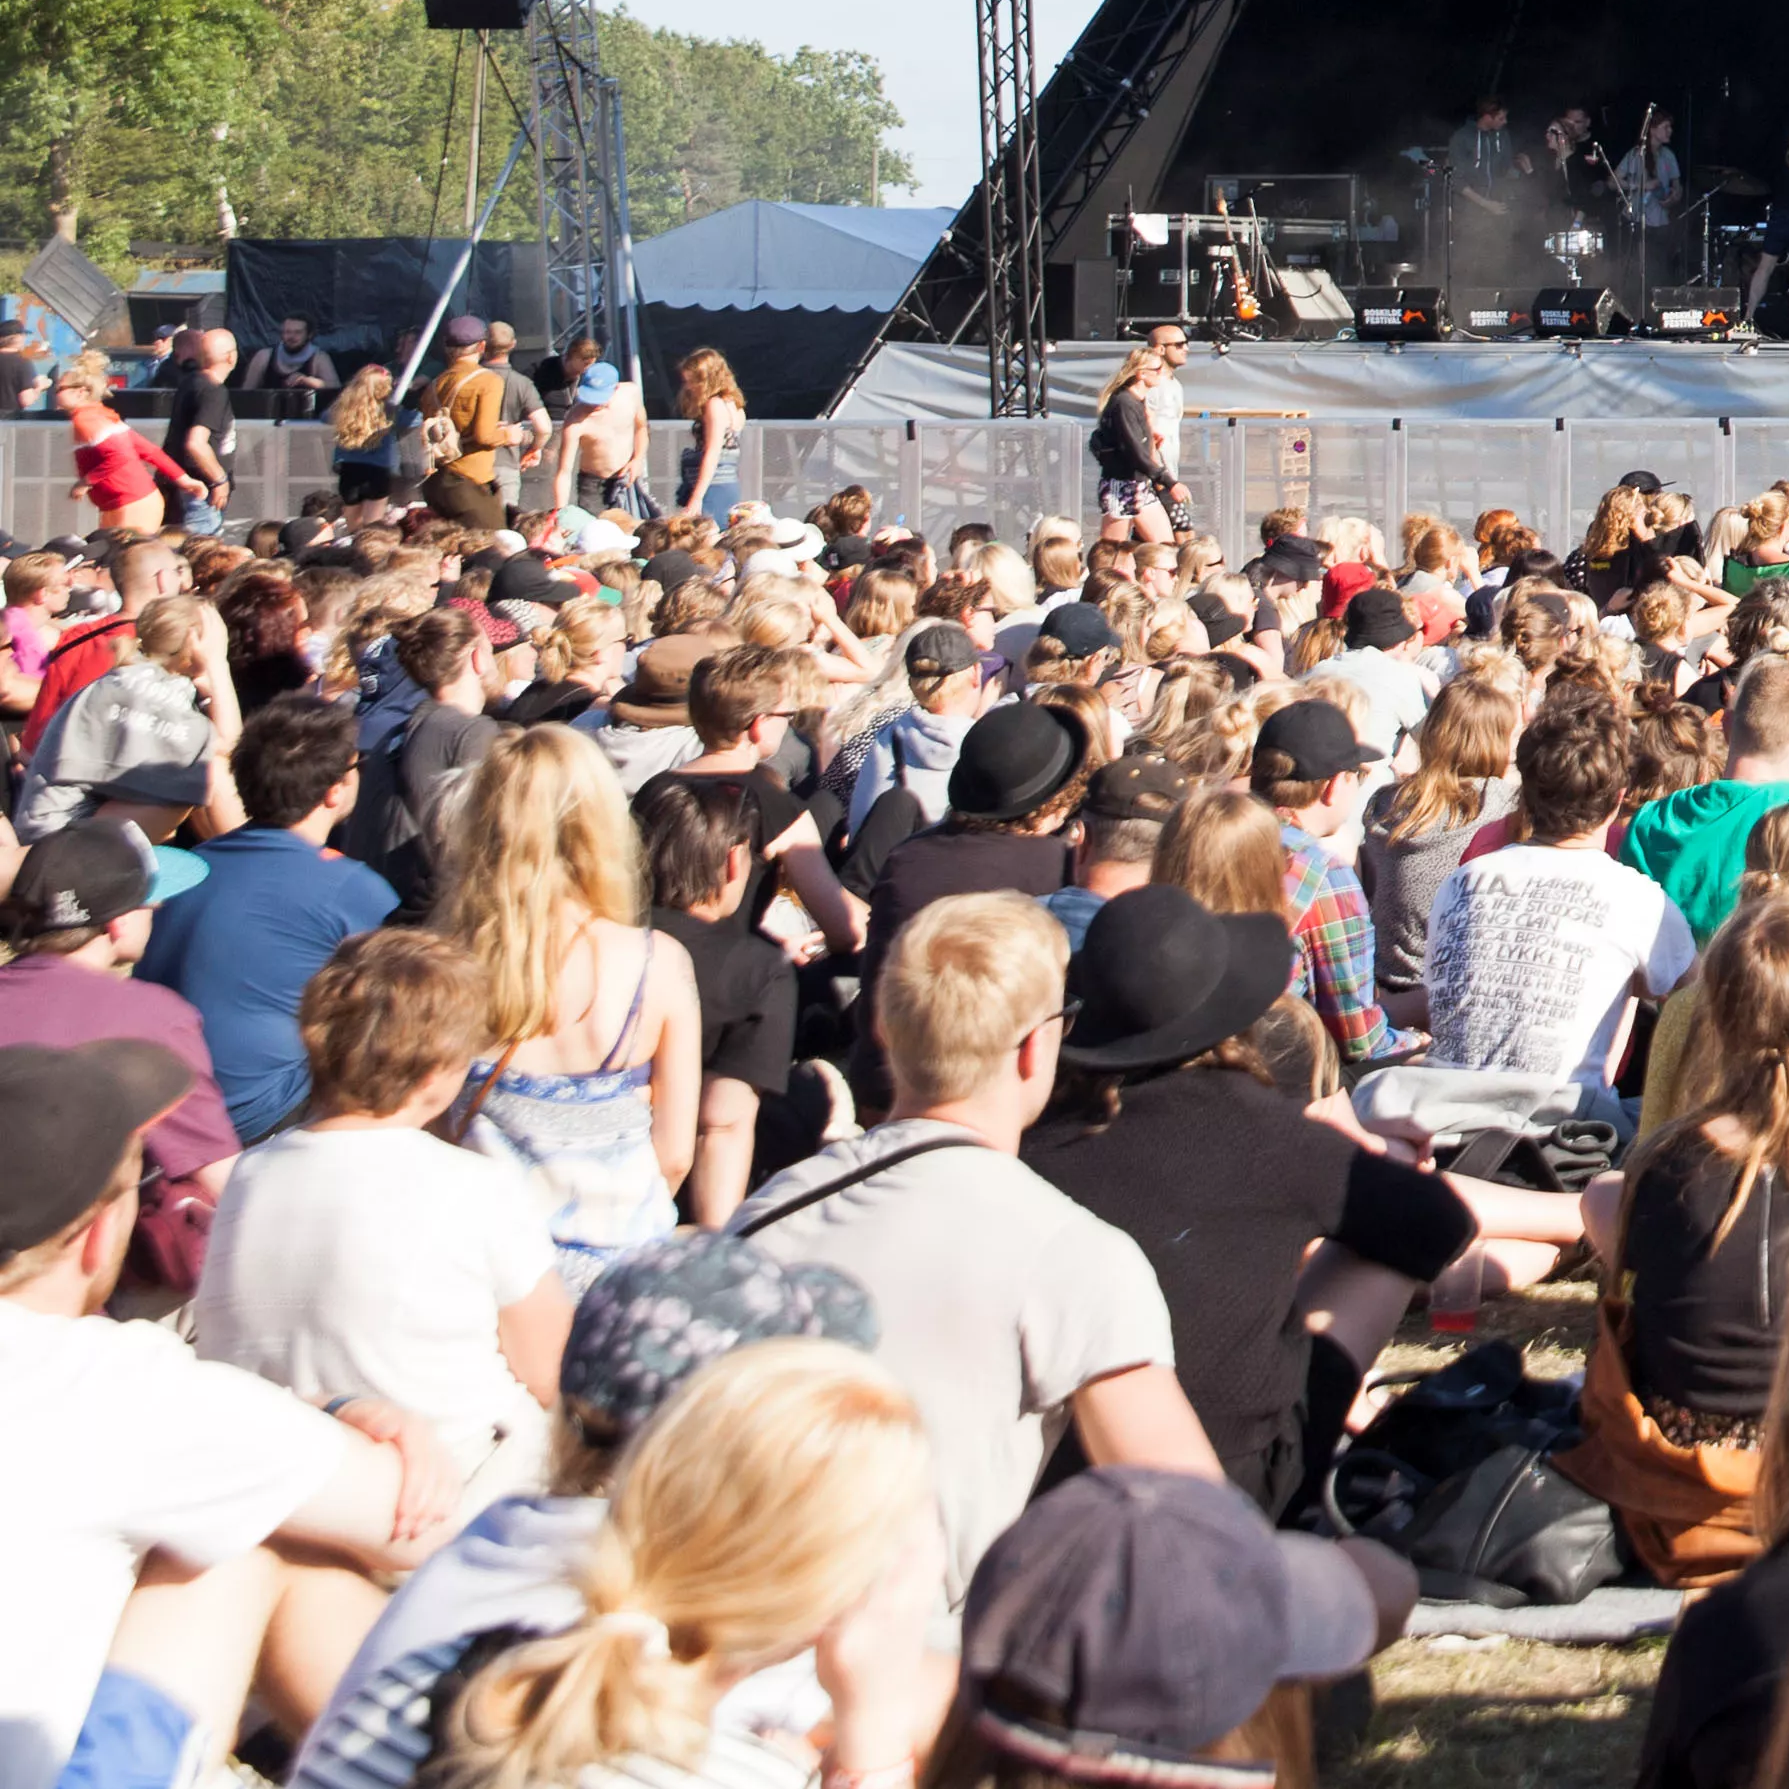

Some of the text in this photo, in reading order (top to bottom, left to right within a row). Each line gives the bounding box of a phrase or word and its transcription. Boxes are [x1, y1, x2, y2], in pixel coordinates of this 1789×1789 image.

[1363, 309, 1402, 317] ROSKILDE
[1469, 311, 1509, 319] ROSKILDE
[1365, 317, 1402, 325] FESTIVAL
[1471, 318, 1508, 326] FESTIVAL
[1491, 898, 1522, 912] THE
[1526, 900, 1606, 928] STOOGES
[1514, 913, 1560, 932] CLAN
[1496, 943, 1584, 972] LYKKE LI
